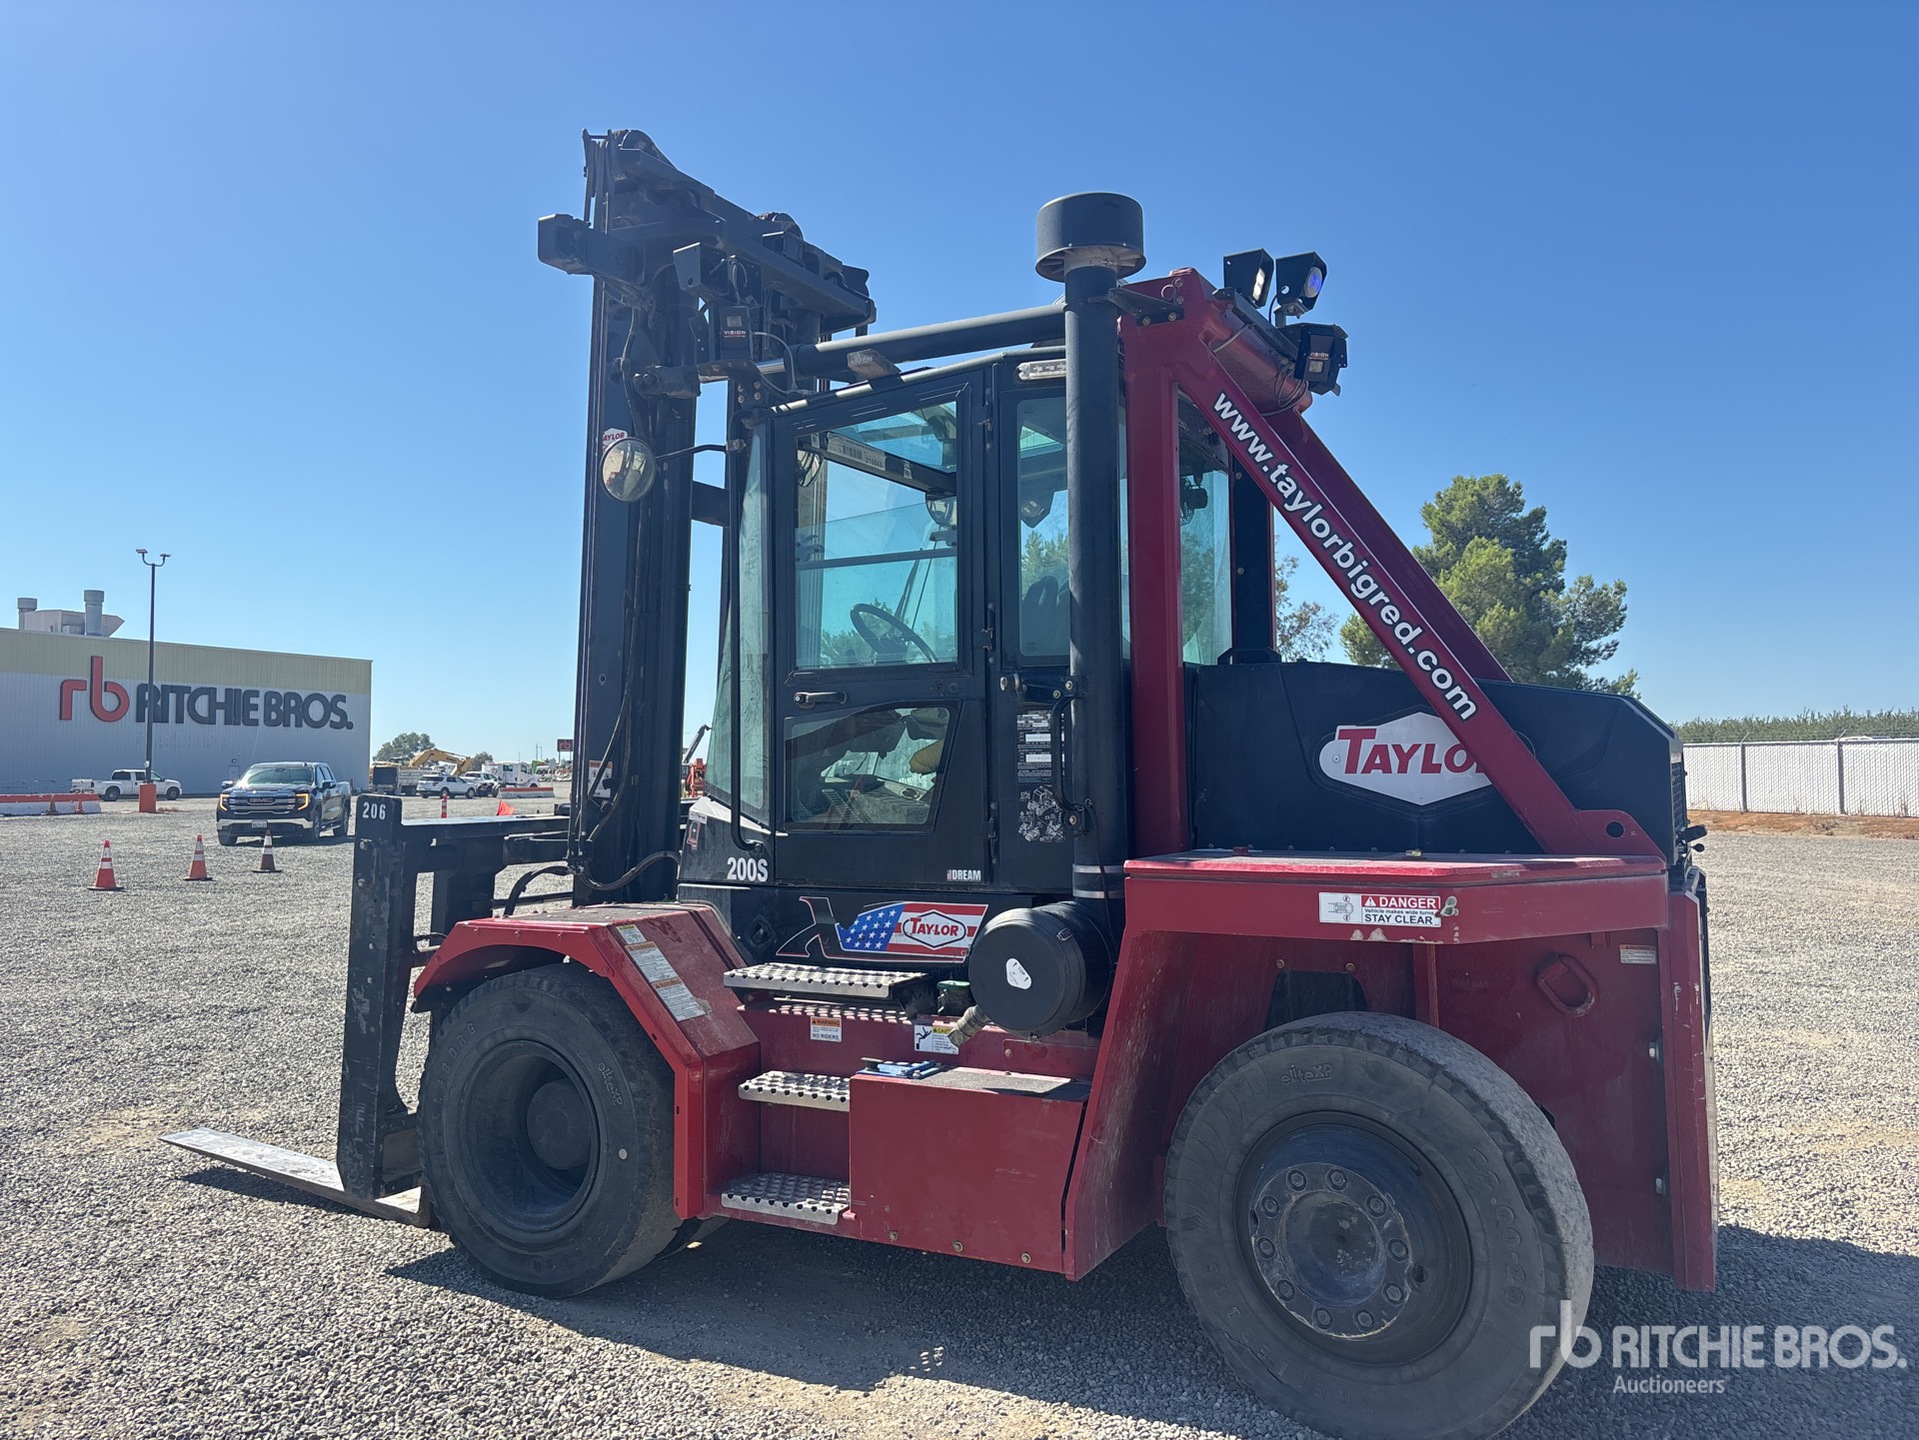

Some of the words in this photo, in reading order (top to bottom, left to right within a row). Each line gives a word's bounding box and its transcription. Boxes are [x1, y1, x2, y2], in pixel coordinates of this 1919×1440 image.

[603, 432, 625, 441] AYLOR
[1213, 393, 1477, 720] www.taylorbigred.com
[136, 683, 259, 727] RITCHIE
[264, 690, 354, 730] BROS.
[1338, 728, 1485, 774] TAYLO
[362, 802, 386, 820] 206
[727, 857, 768, 882] 200S
[1380, 896, 1437, 908] DANGER
[910, 917, 959, 936] TAYLOR
[1364, 913, 1392, 923] STAY
[1394, 915, 1433, 925] CLEAR
